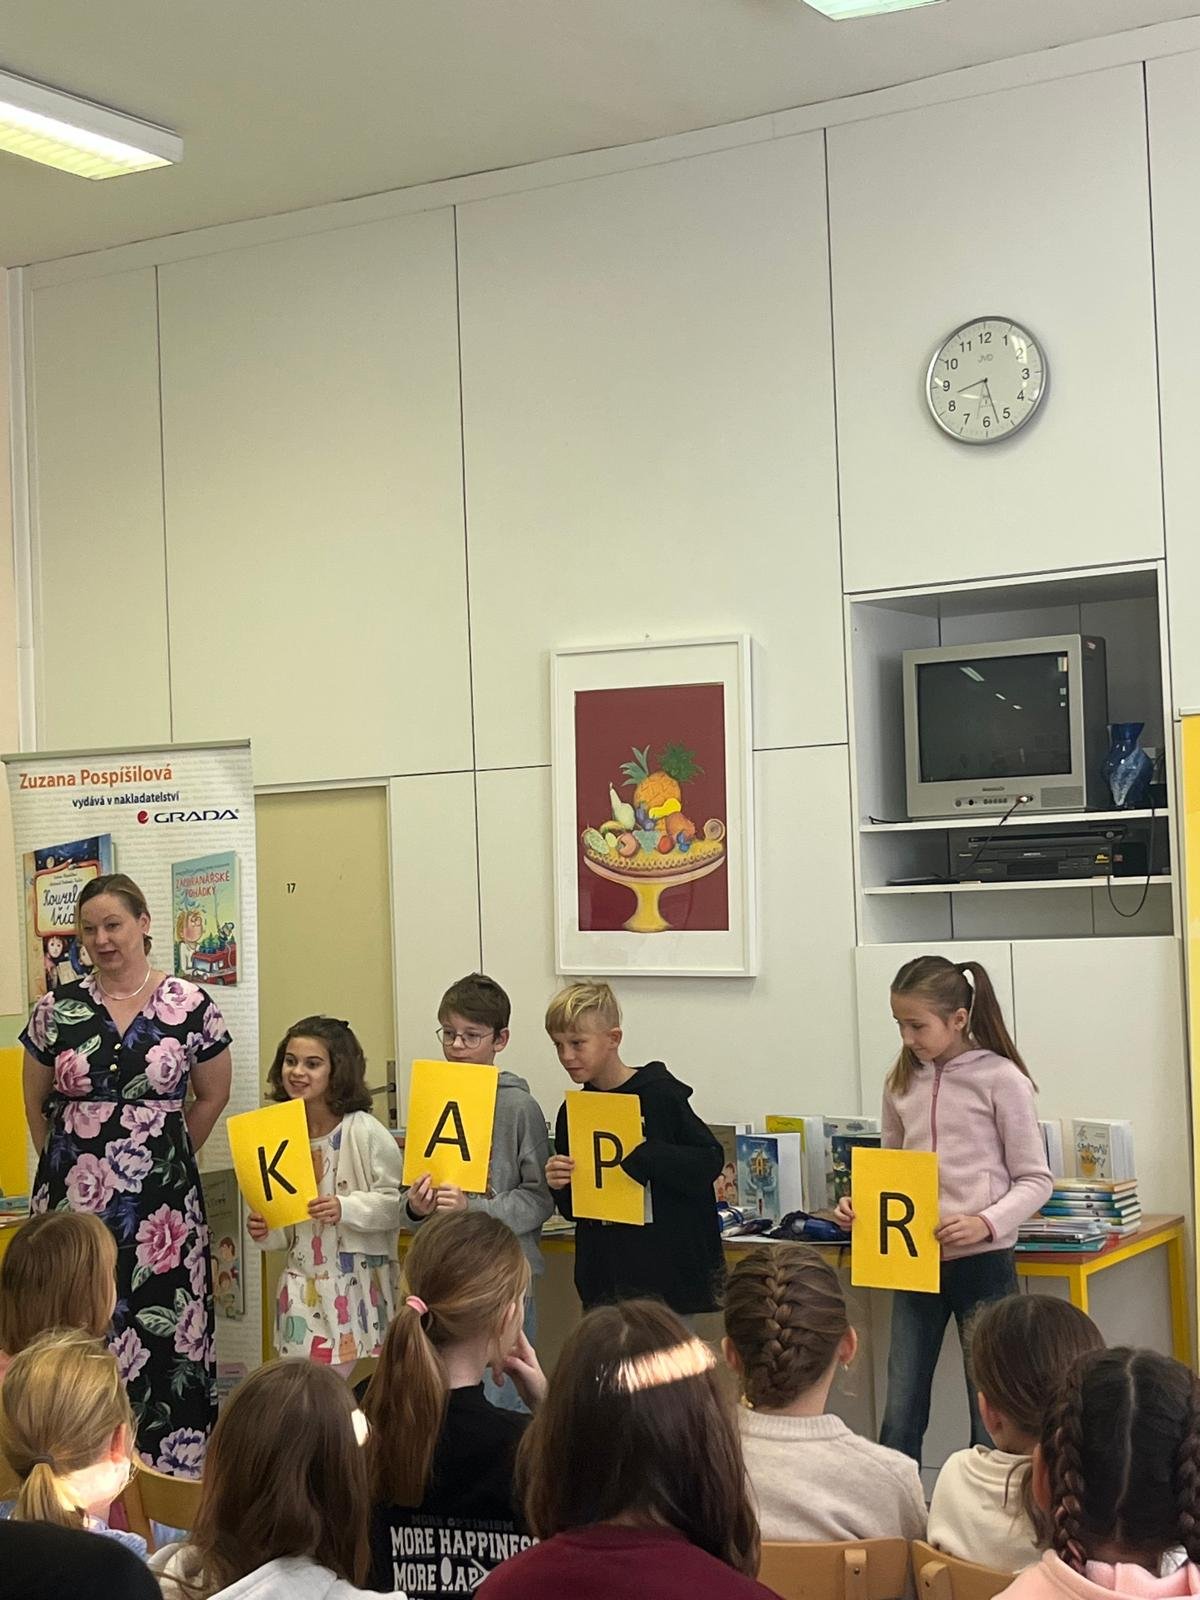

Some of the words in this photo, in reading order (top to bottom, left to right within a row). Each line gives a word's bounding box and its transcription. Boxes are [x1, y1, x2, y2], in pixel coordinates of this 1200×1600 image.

[978, 332, 992, 344] 12
[1002, 335, 1008, 346] 1
[960, 341, 972, 352] 11
[1016, 348, 1024, 360] 2
[945, 358, 959, 370] 10
[1021, 368, 1030, 380] 3
[942, 380, 951, 392] 9
[1017, 390, 1025, 401] 4
[948, 400, 956, 412] 8
[963, 413, 971, 425] 7
[1002, 407, 1011, 419] 5
[982, 416, 991, 428] 6
[19, 773, 76, 790] Zuzana
[80, 763, 173, 788] Pospíšilová
[72, 793, 105, 809] vydává
[106, 797, 113, 805] v
[114, 790, 180, 806] nakladatelství
[154, 809, 239, 824] GRADA
[287, 882, 296, 894] 17
[424, 1101, 471, 1162] A
[593, 1130, 625, 1189] P
[257, 1139, 298, 1201] K
[879, 1191, 919, 1258] R
[390, 1525, 436, 1557] MORE
[393, 1561, 437, 1592] MORE
